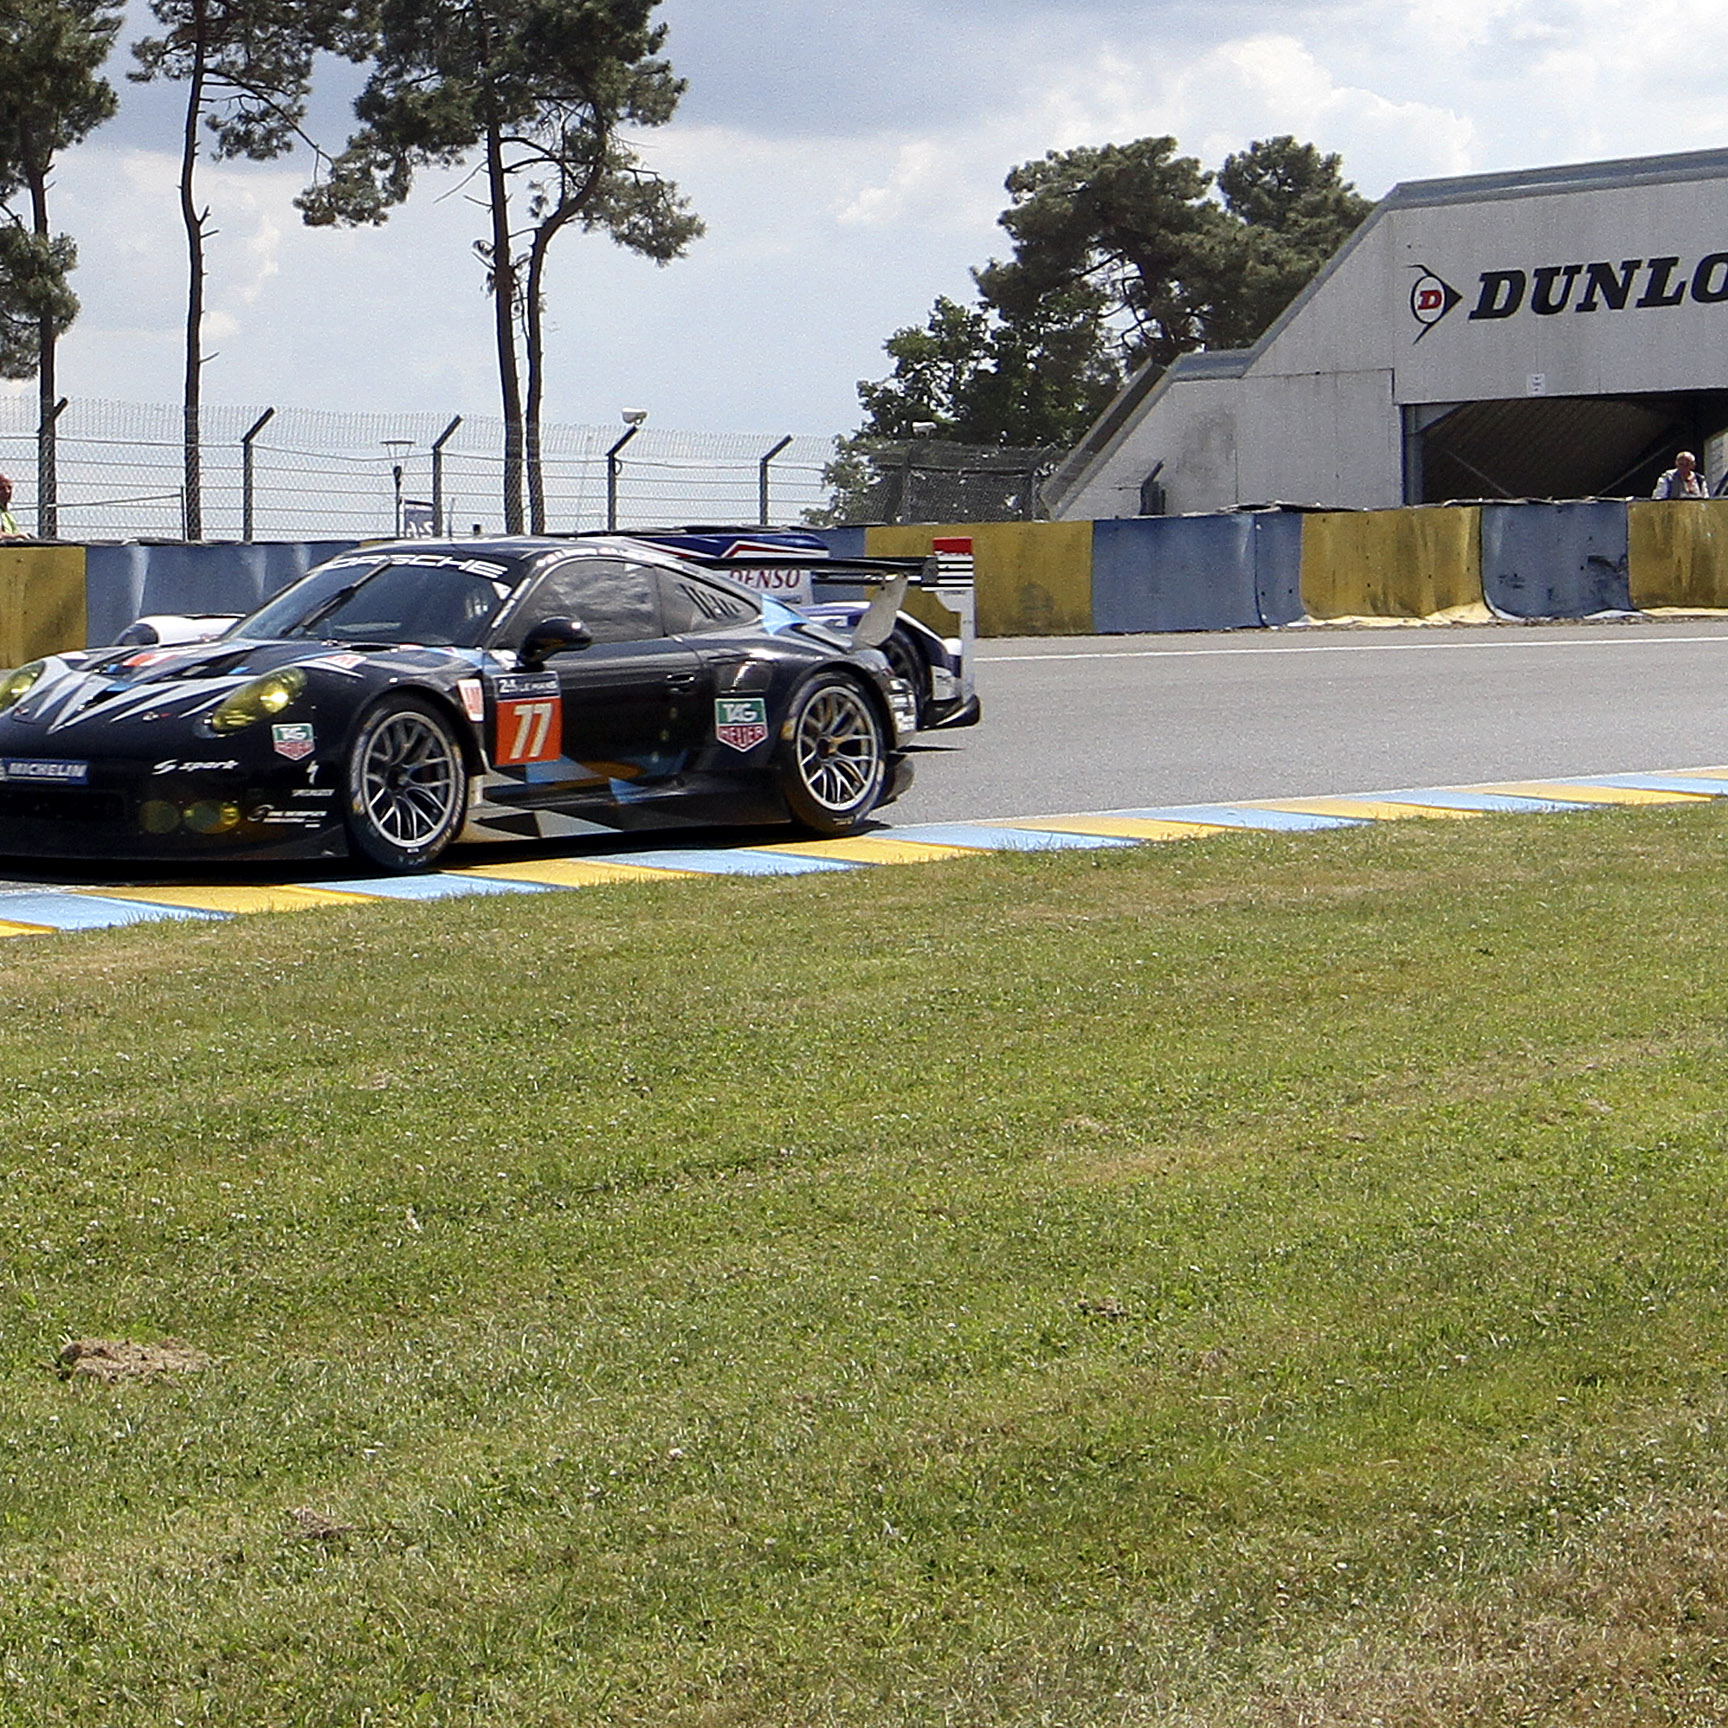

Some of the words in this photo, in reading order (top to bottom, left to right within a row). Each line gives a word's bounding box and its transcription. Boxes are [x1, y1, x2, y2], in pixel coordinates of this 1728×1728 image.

[722, 702, 758, 723] TAG
[509, 702, 553, 760] 77
[718, 725, 766, 748] HEUER
[7, 762, 88, 778] MICHELIN
[178, 759, 240, 772] spark
